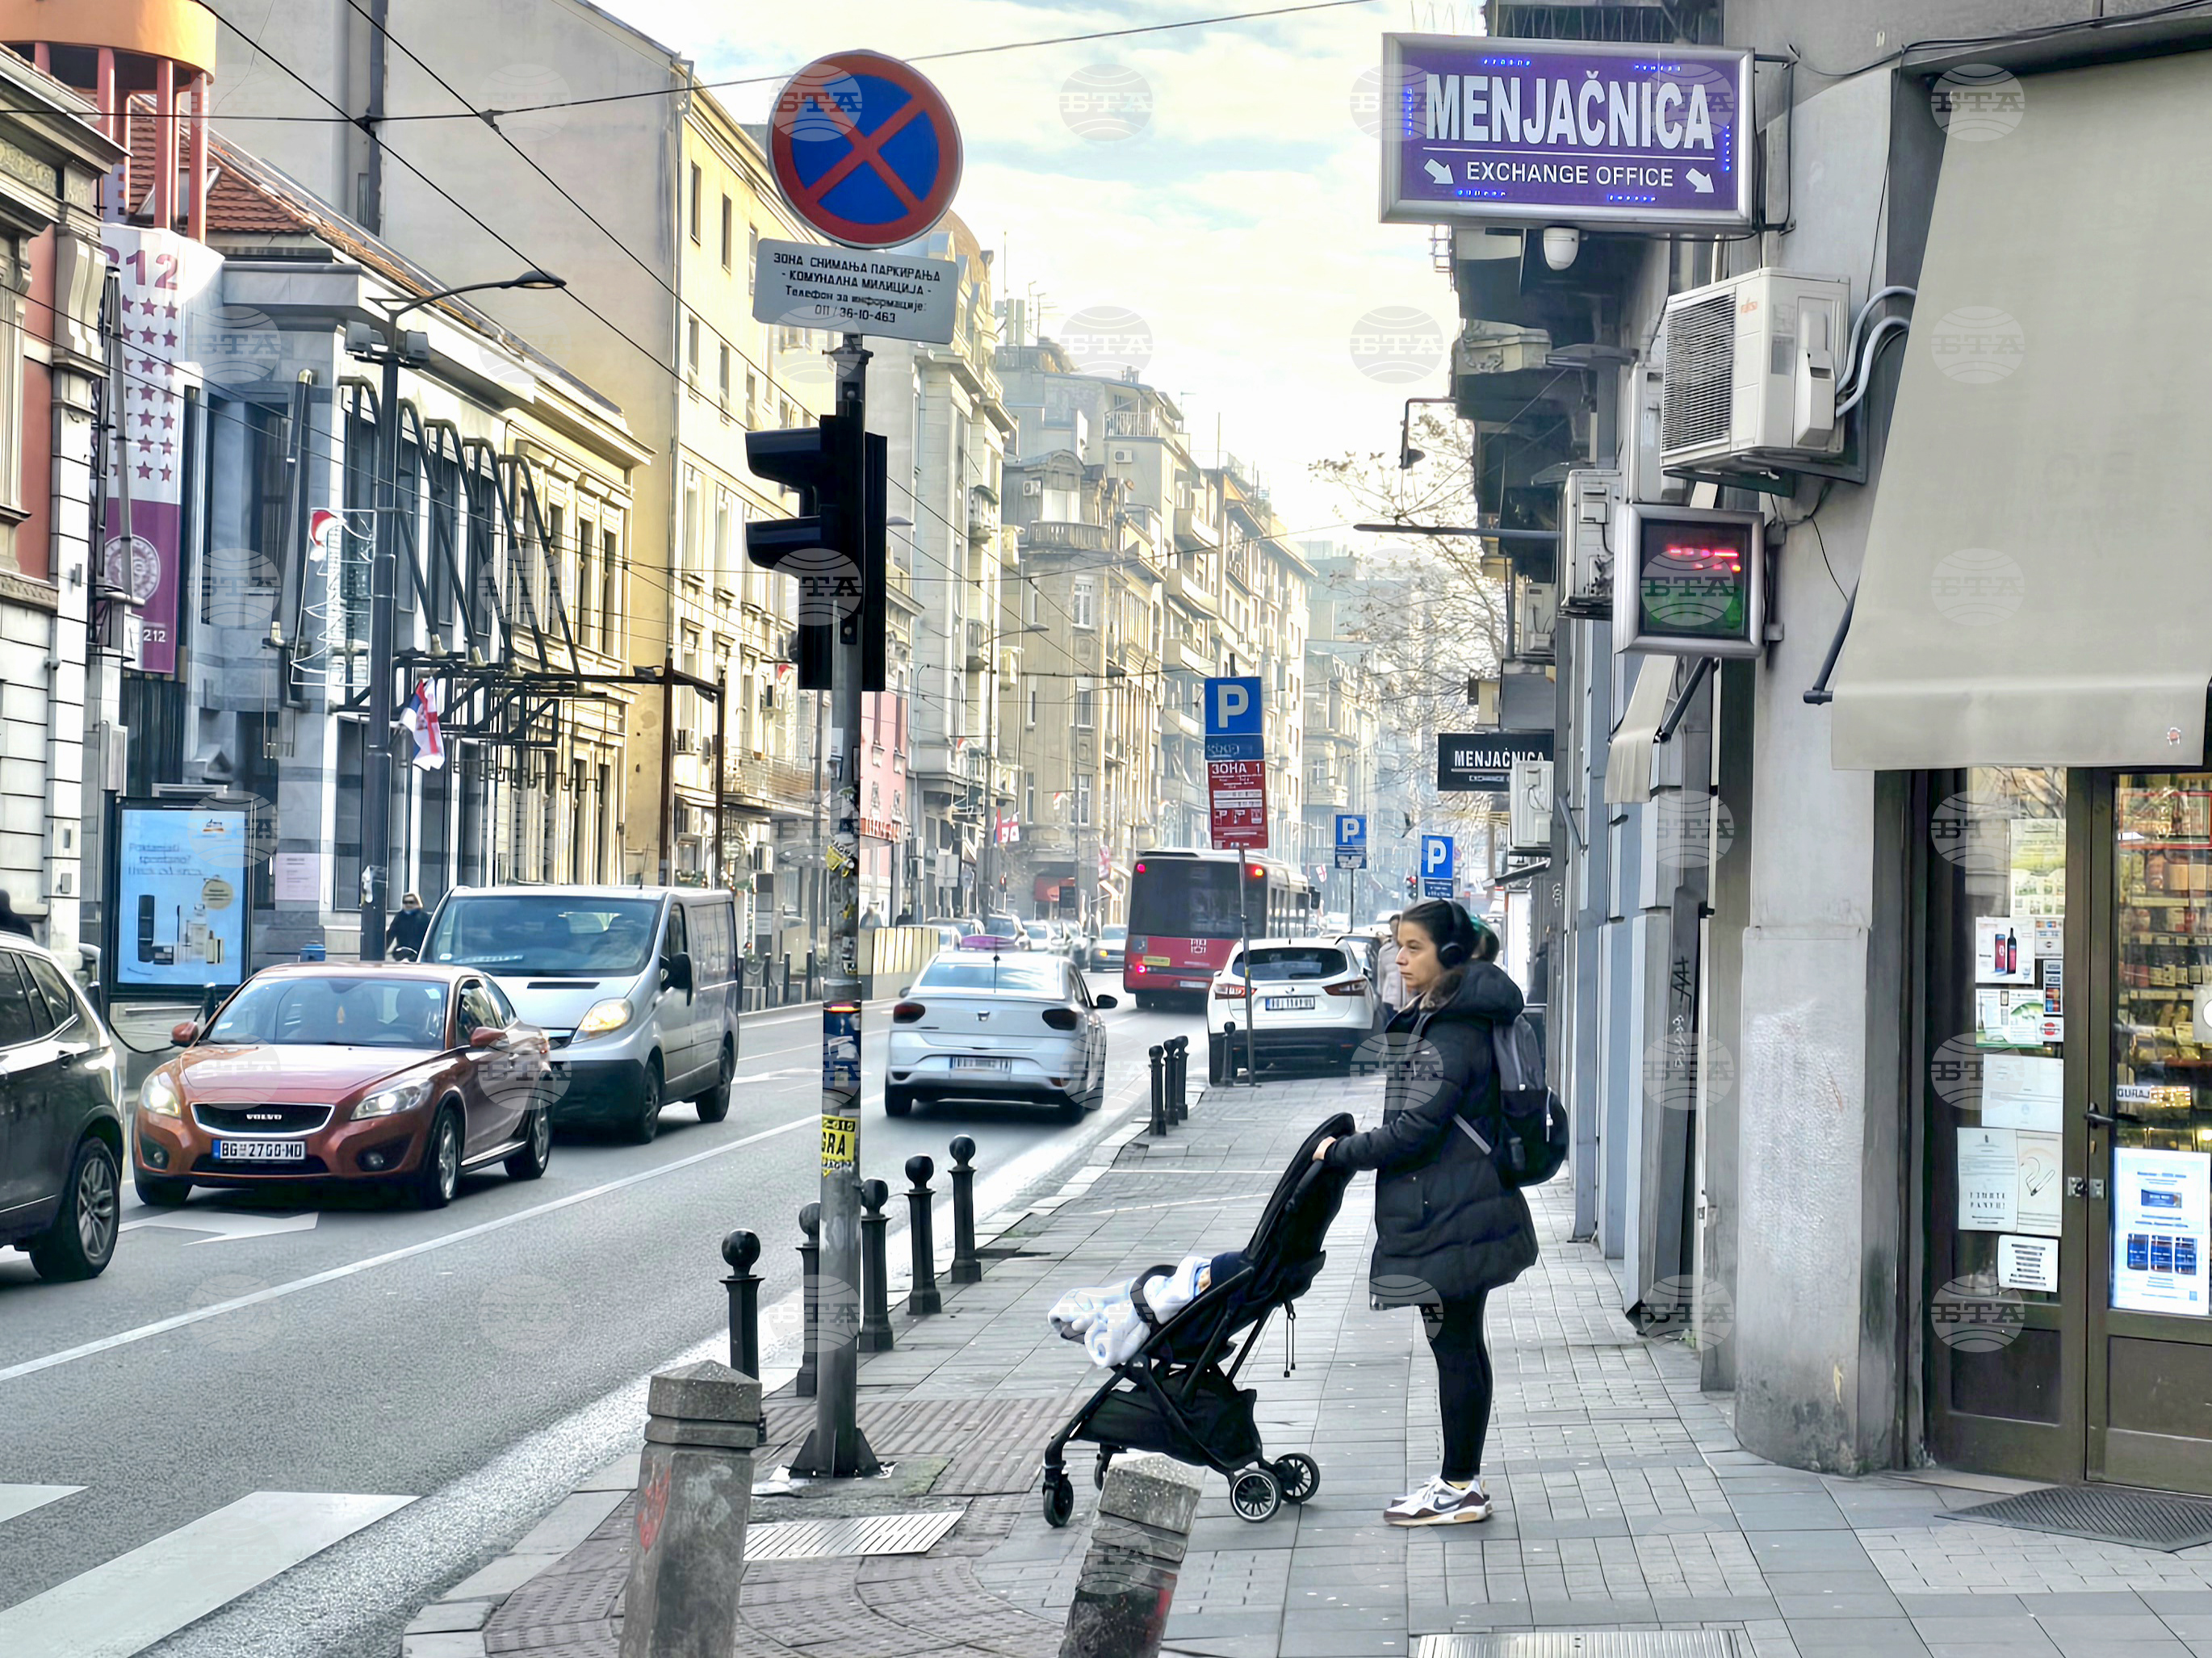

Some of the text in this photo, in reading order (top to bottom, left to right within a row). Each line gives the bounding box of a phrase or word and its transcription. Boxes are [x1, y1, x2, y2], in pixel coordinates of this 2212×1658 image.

[1426, 70, 1715, 149] MENJAČNICA
[1467, 161, 1674, 187] EXCHANGE OFFICE
[773, 253, 941, 282] ЗОНА СНИМАЊА ПАРКИРАЊА
[790, 270, 858, 287] КОМУНАЛНА
[861, 278, 924, 295] МИЛИЦИЈА
[815, 304, 830, 316] 011
[840, 307, 895, 323] 36-10-463
[143, 629, 166, 643] 212
[1217, 685, 1249, 728] P
[1212, 763, 1247, 774] ЗОНА
[1342, 818, 1359, 843] P
[1427, 839, 1447, 873] P
